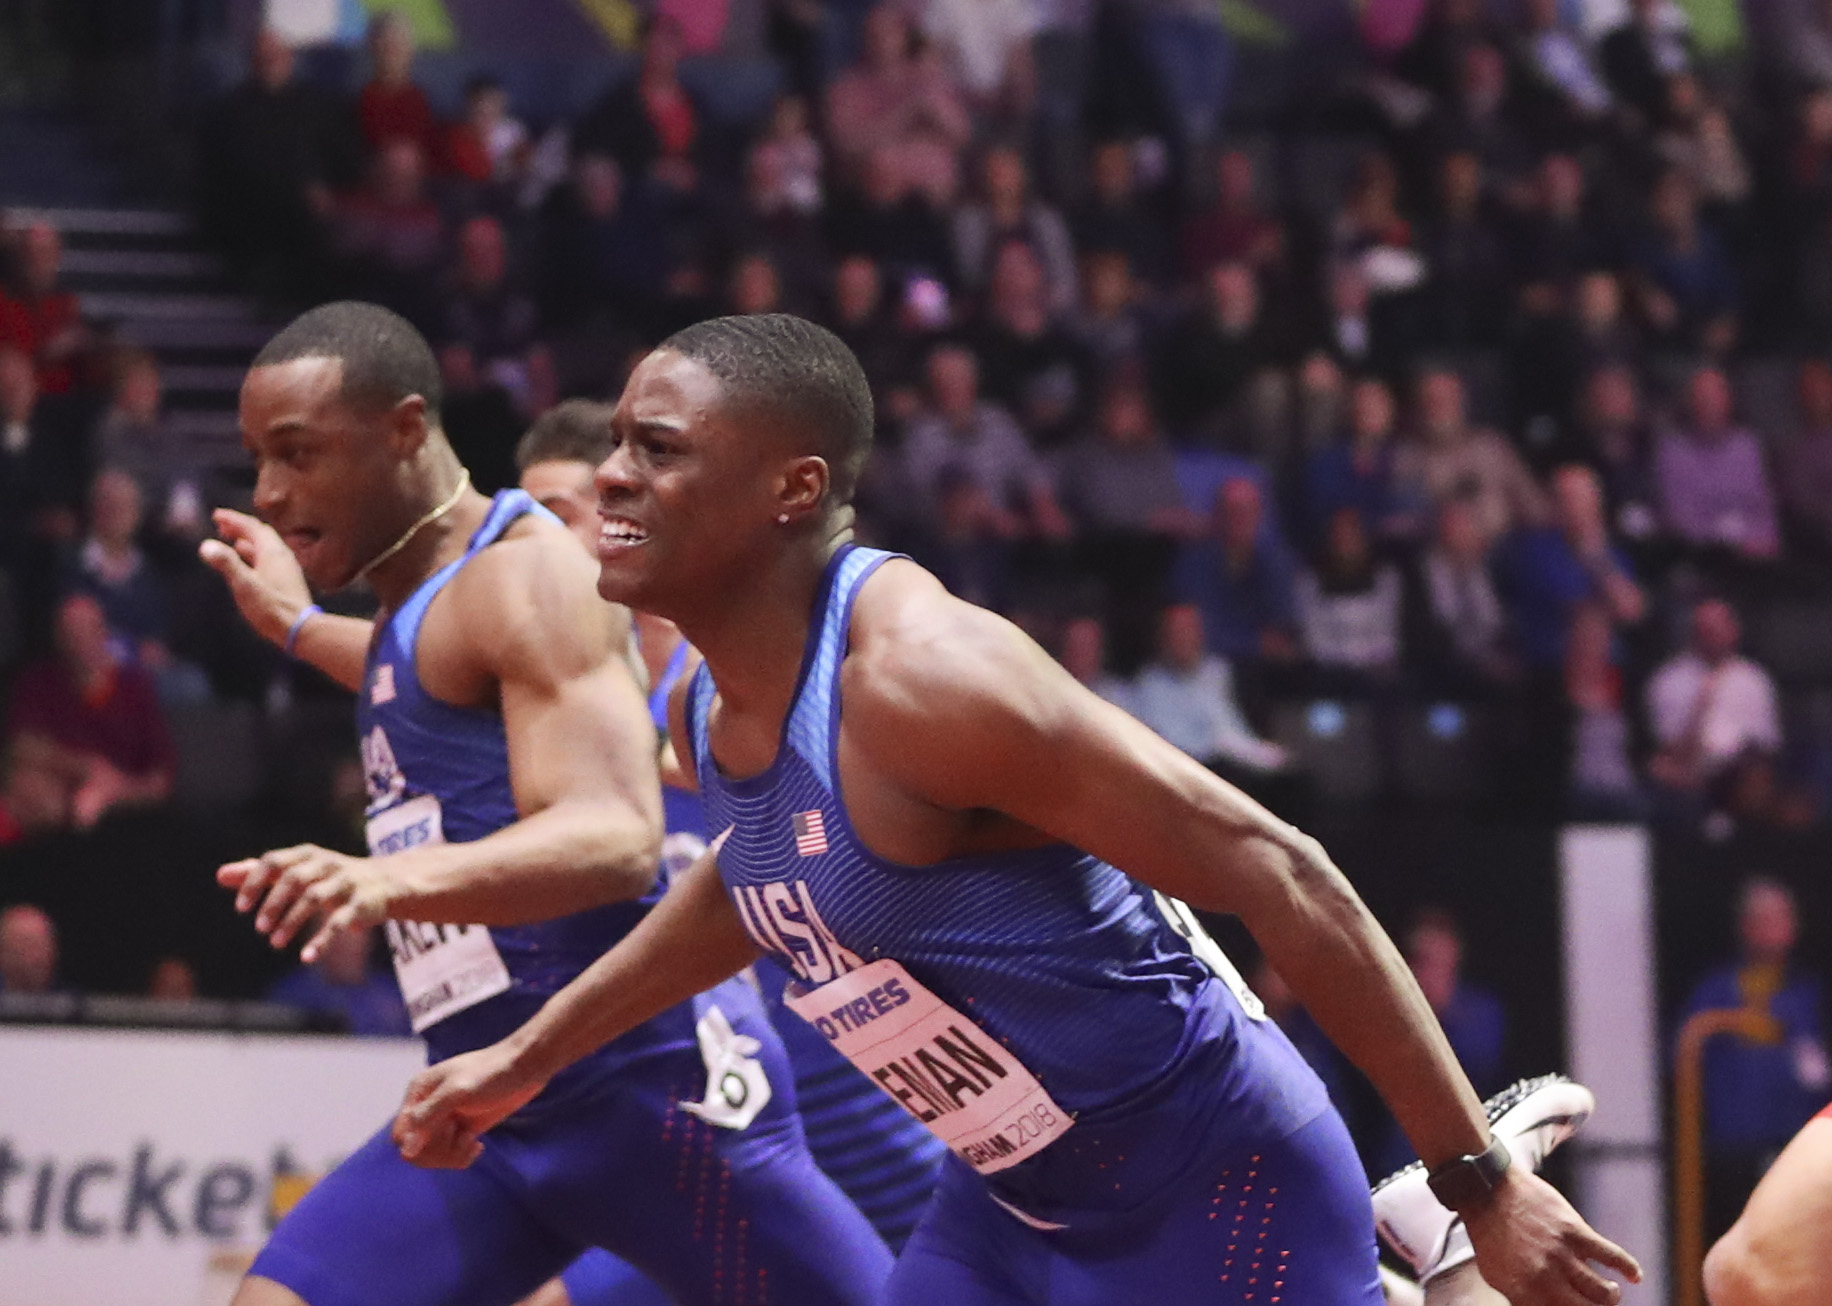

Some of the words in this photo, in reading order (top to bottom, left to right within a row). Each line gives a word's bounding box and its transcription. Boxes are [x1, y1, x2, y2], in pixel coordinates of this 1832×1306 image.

[732, 879, 868, 984] USA
[831, 977, 911, 1033] TIRES
[1004, 1102, 1059, 1147] 2018
